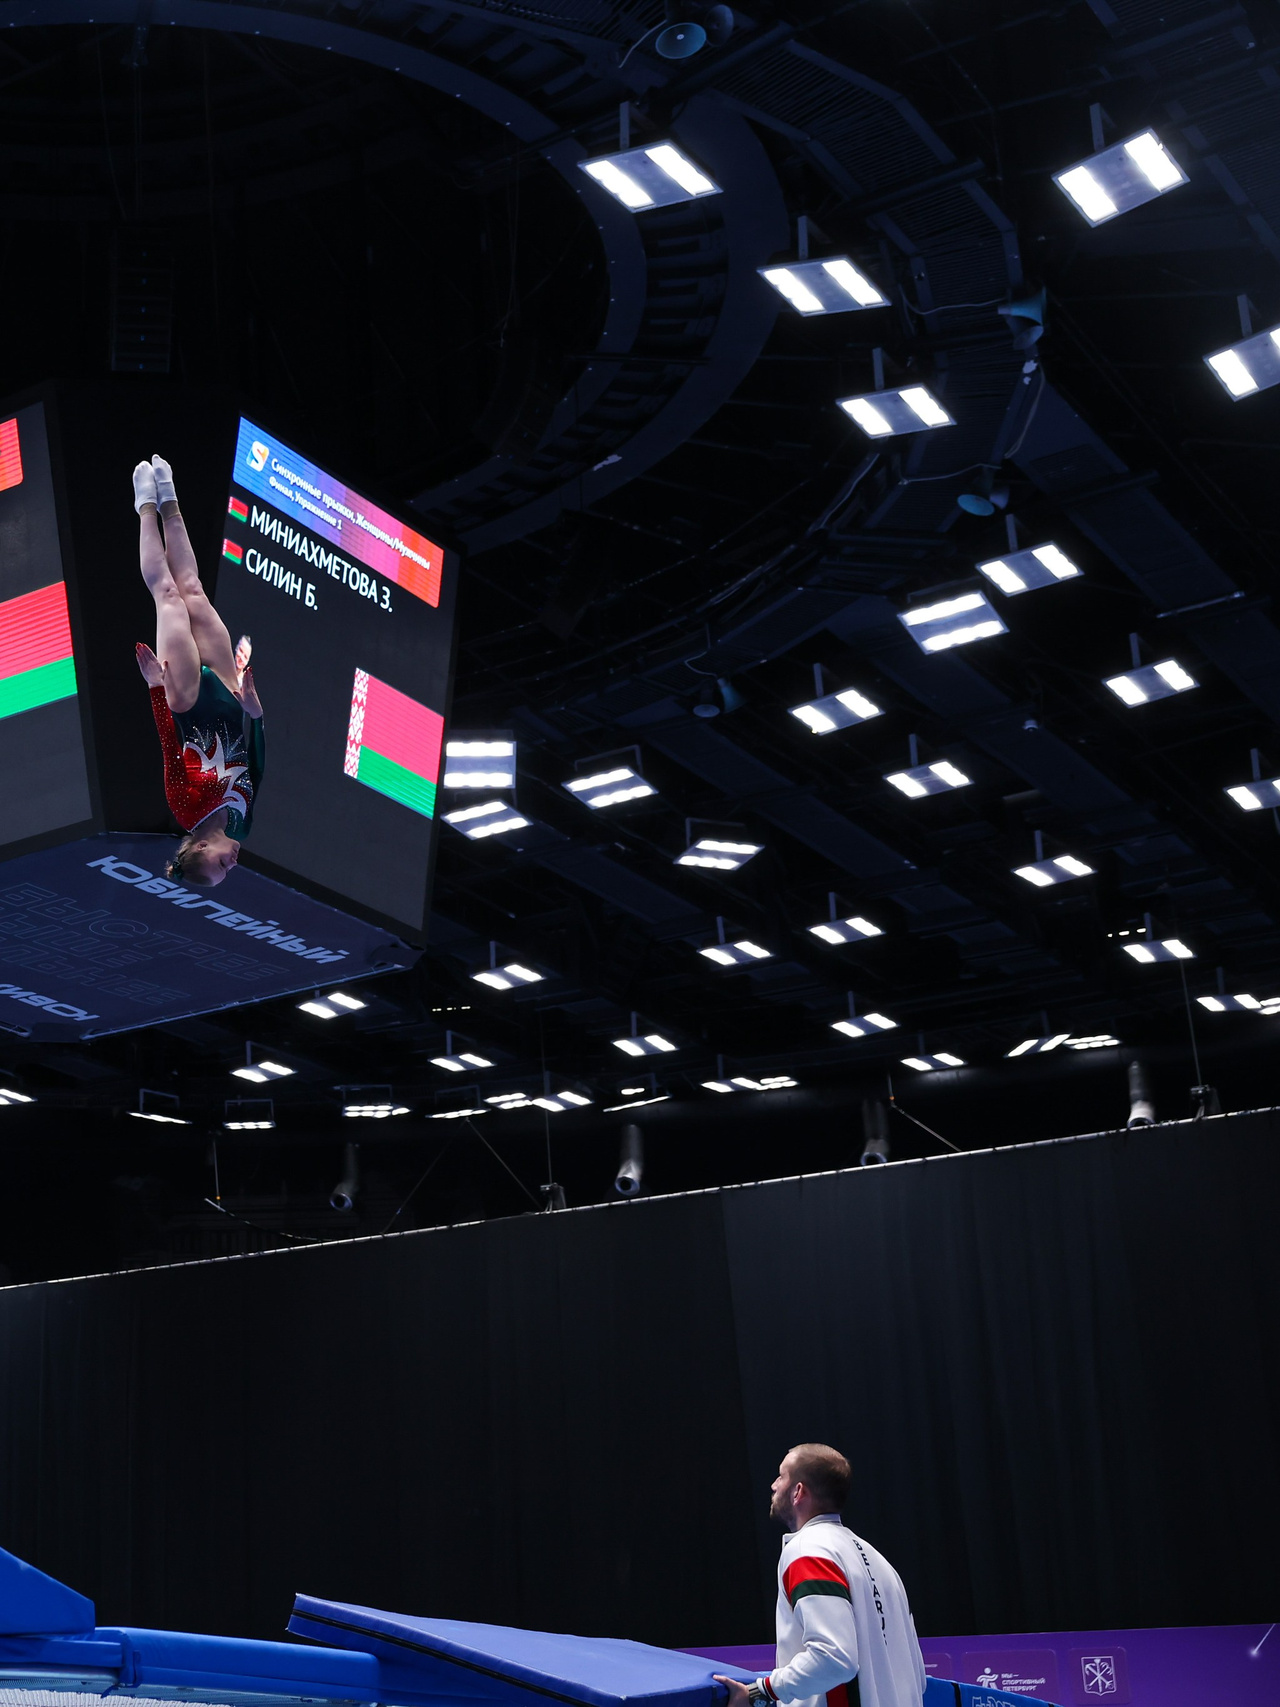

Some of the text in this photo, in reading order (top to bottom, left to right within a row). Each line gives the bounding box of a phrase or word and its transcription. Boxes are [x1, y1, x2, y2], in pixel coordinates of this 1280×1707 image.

[269, 476, 342, 530] Финал, Упражнение 1
[271, 458, 321, 499] Синхронные
[322, 493, 356, 524] прыжки,
[245, 549, 318, 610] СИЛИН Б.
[250, 505, 393, 612] МИНИАХМЕТОВА З.
[86, 855, 350, 964] ЮБИЛЕЙНЫЙ
[852, 1539, 888, 1646] BELAR
